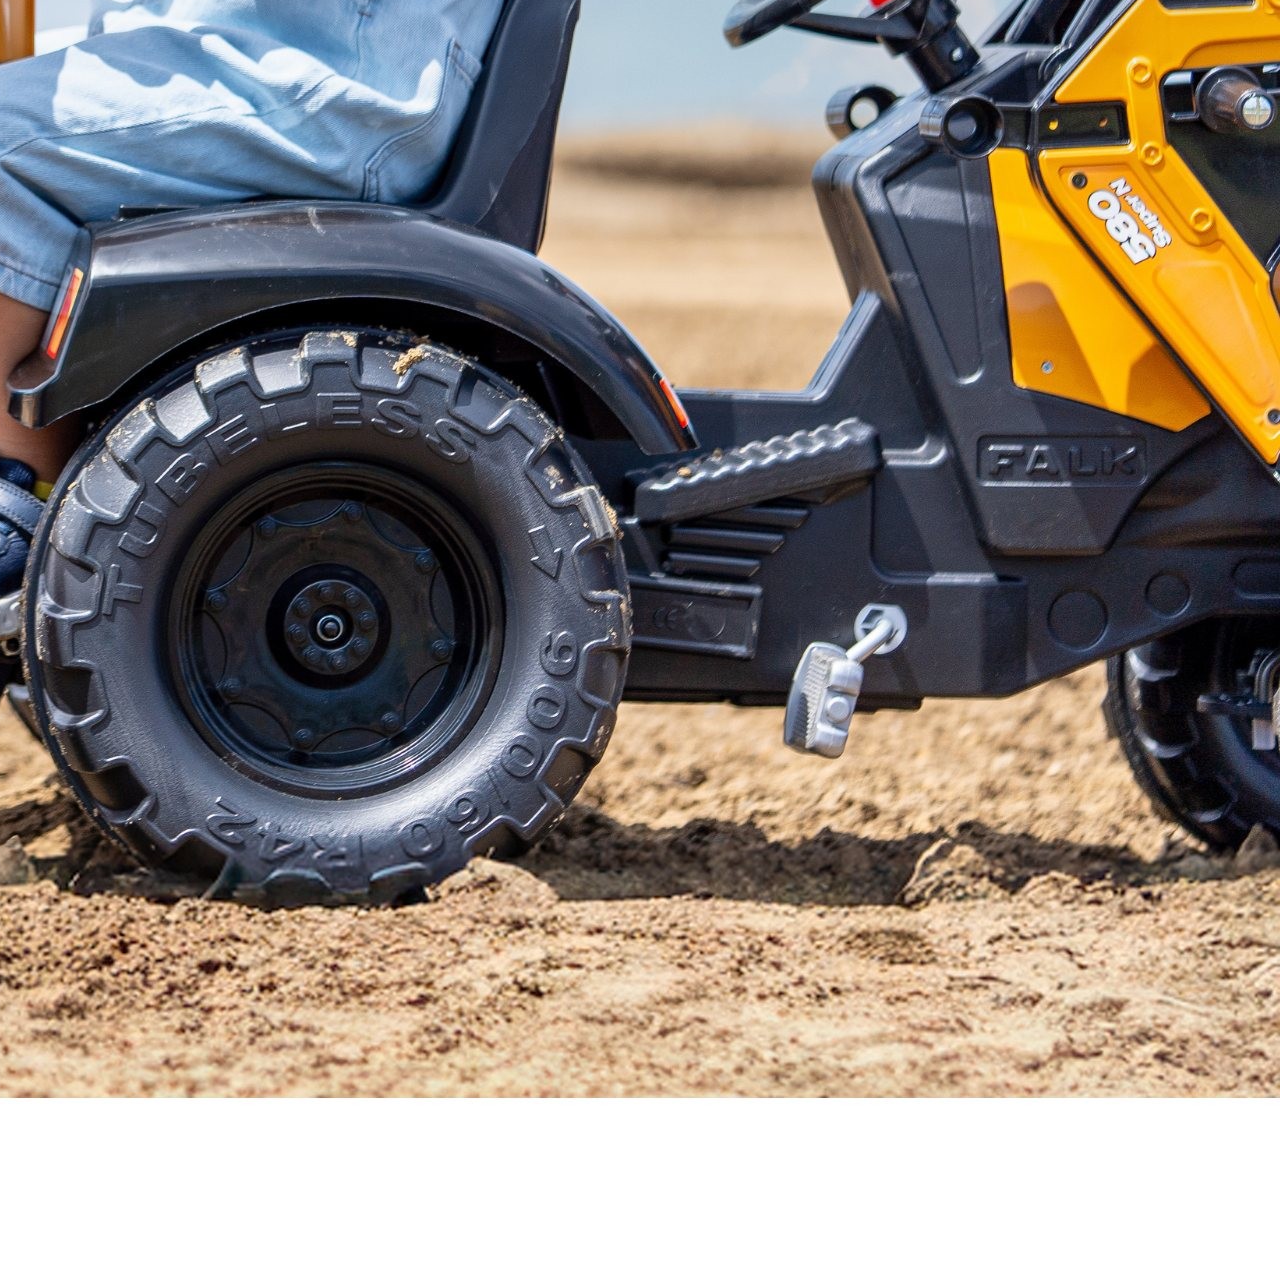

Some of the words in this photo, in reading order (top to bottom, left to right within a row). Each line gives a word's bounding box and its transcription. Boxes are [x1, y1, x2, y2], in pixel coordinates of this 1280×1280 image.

[1109, 177, 1132, 197] N
[1088, 189, 1157, 265] 580
[1124, 194, 1172, 249] Super
[986, 443, 1136, 476] FALK
[102, 391, 476, 616] TUBELESS
[396, 630, 579, 859] 900/60
